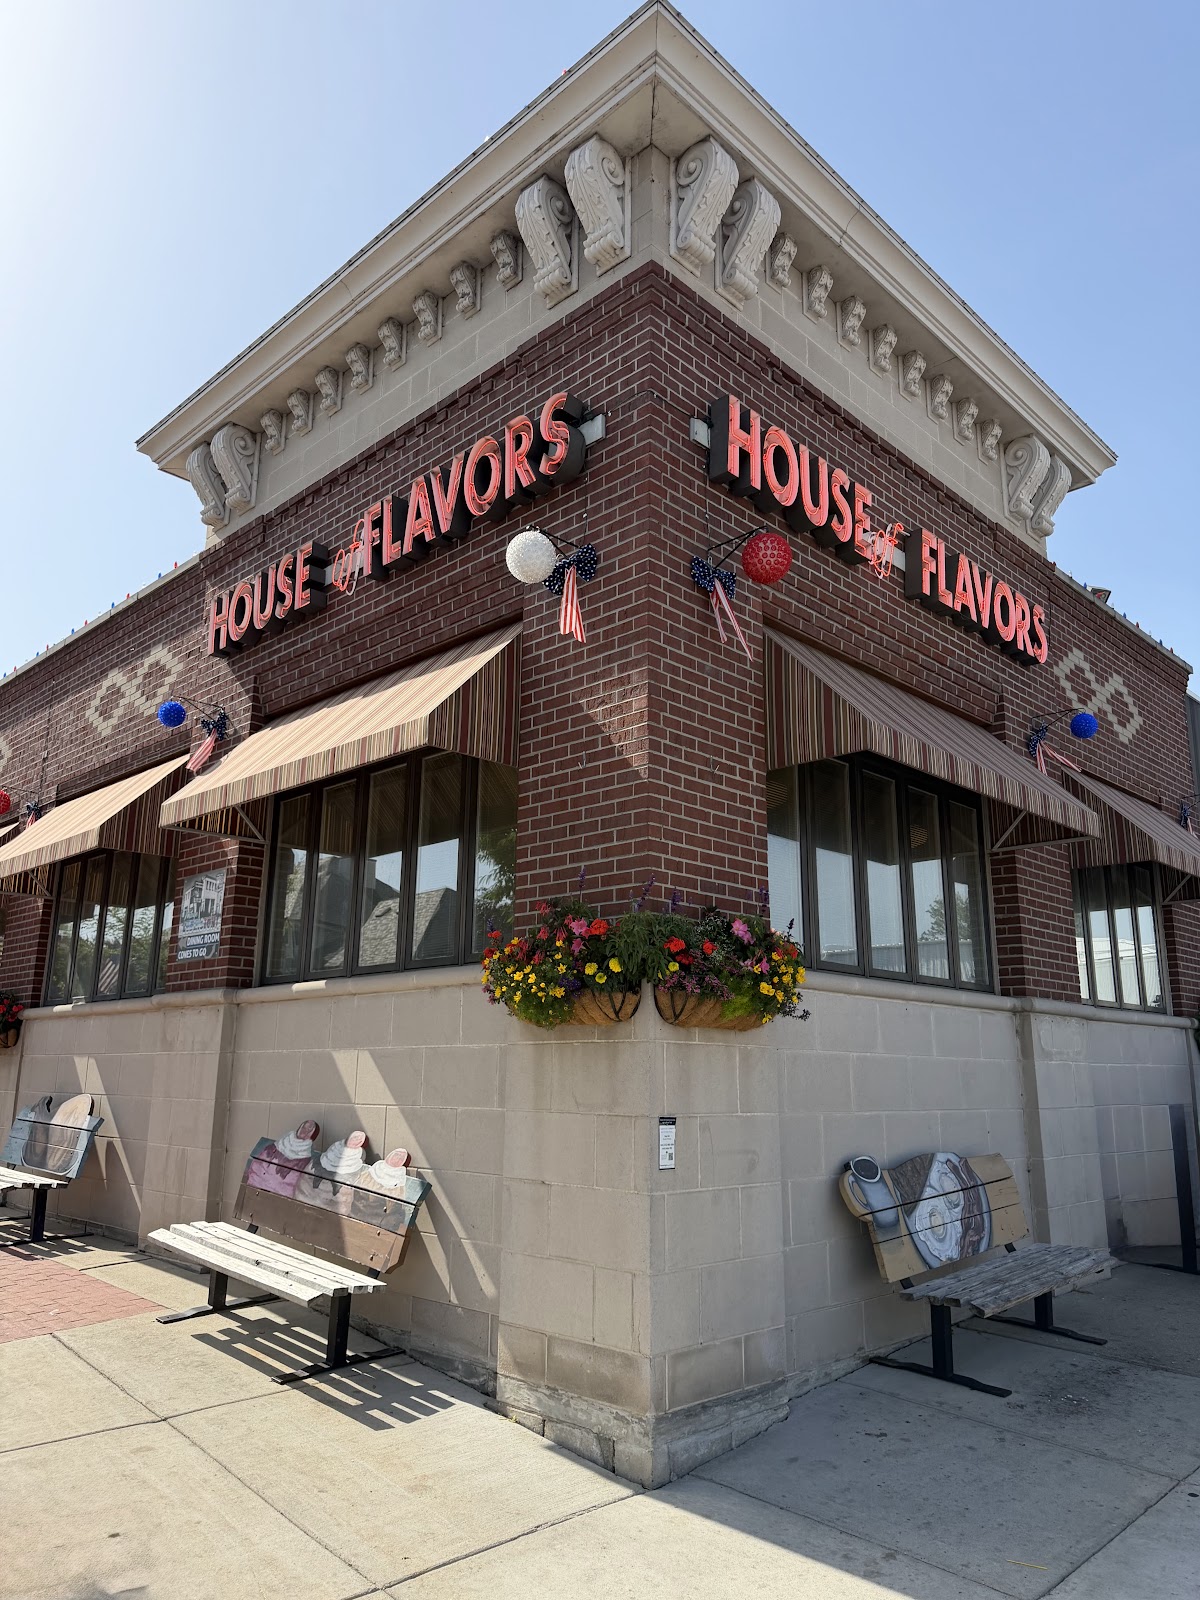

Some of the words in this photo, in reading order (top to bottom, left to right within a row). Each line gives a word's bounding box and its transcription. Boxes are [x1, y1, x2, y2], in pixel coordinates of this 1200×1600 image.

[208, 541, 316, 657] HOUSE
[332, 519, 364, 595] of
[363, 392, 574, 578] FLAVORS
[727, 394, 873, 562] HOUSE
[869, 522, 906, 579] of
[920, 529, 1047, 665] FLAVORS
[187, 934, 204, 946] DINING
[204, 932, 220, 944] ROOM
[192, 948, 199, 957] TO
[199, 947, 207, 957] GO
